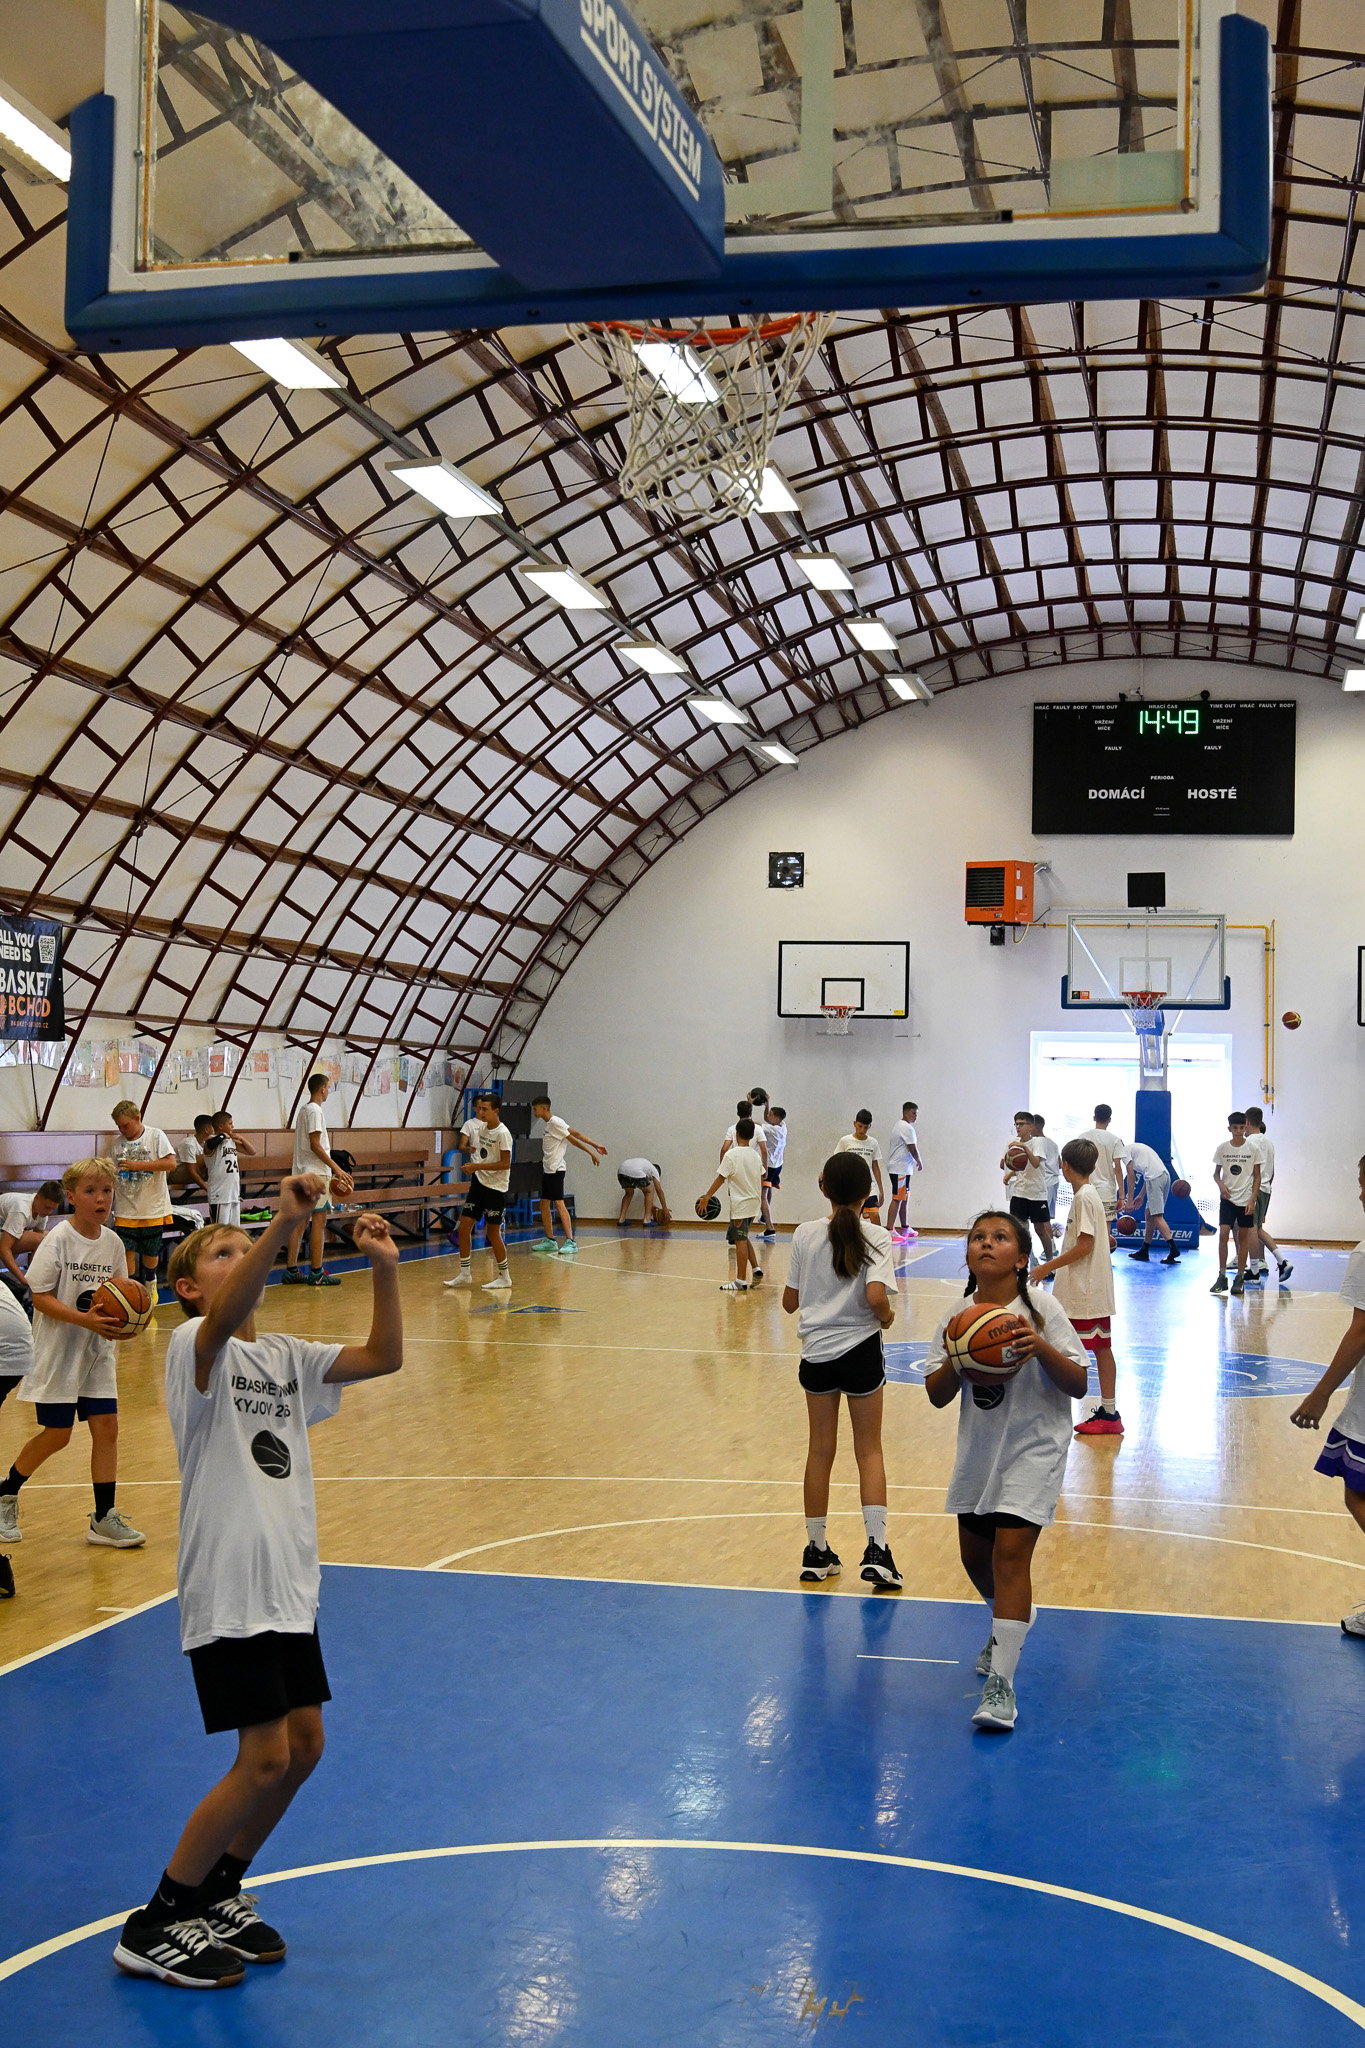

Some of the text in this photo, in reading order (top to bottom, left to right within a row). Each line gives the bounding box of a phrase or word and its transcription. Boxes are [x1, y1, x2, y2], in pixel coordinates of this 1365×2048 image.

[641, 61, 702, 185] SYSTEM
[1139, 709, 1199, 735] 14:49
[1088, 786, 1145, 799] DOMÁCÍ
[1187, 786, 1237, 799] HOSTÉ
[14, 931, 35, 948] YOU
[0, 944, 32, 963] NEED IS
[0, 967, 52, 996] BASKET
[233, 1396, 273, 1416] KYJOV
